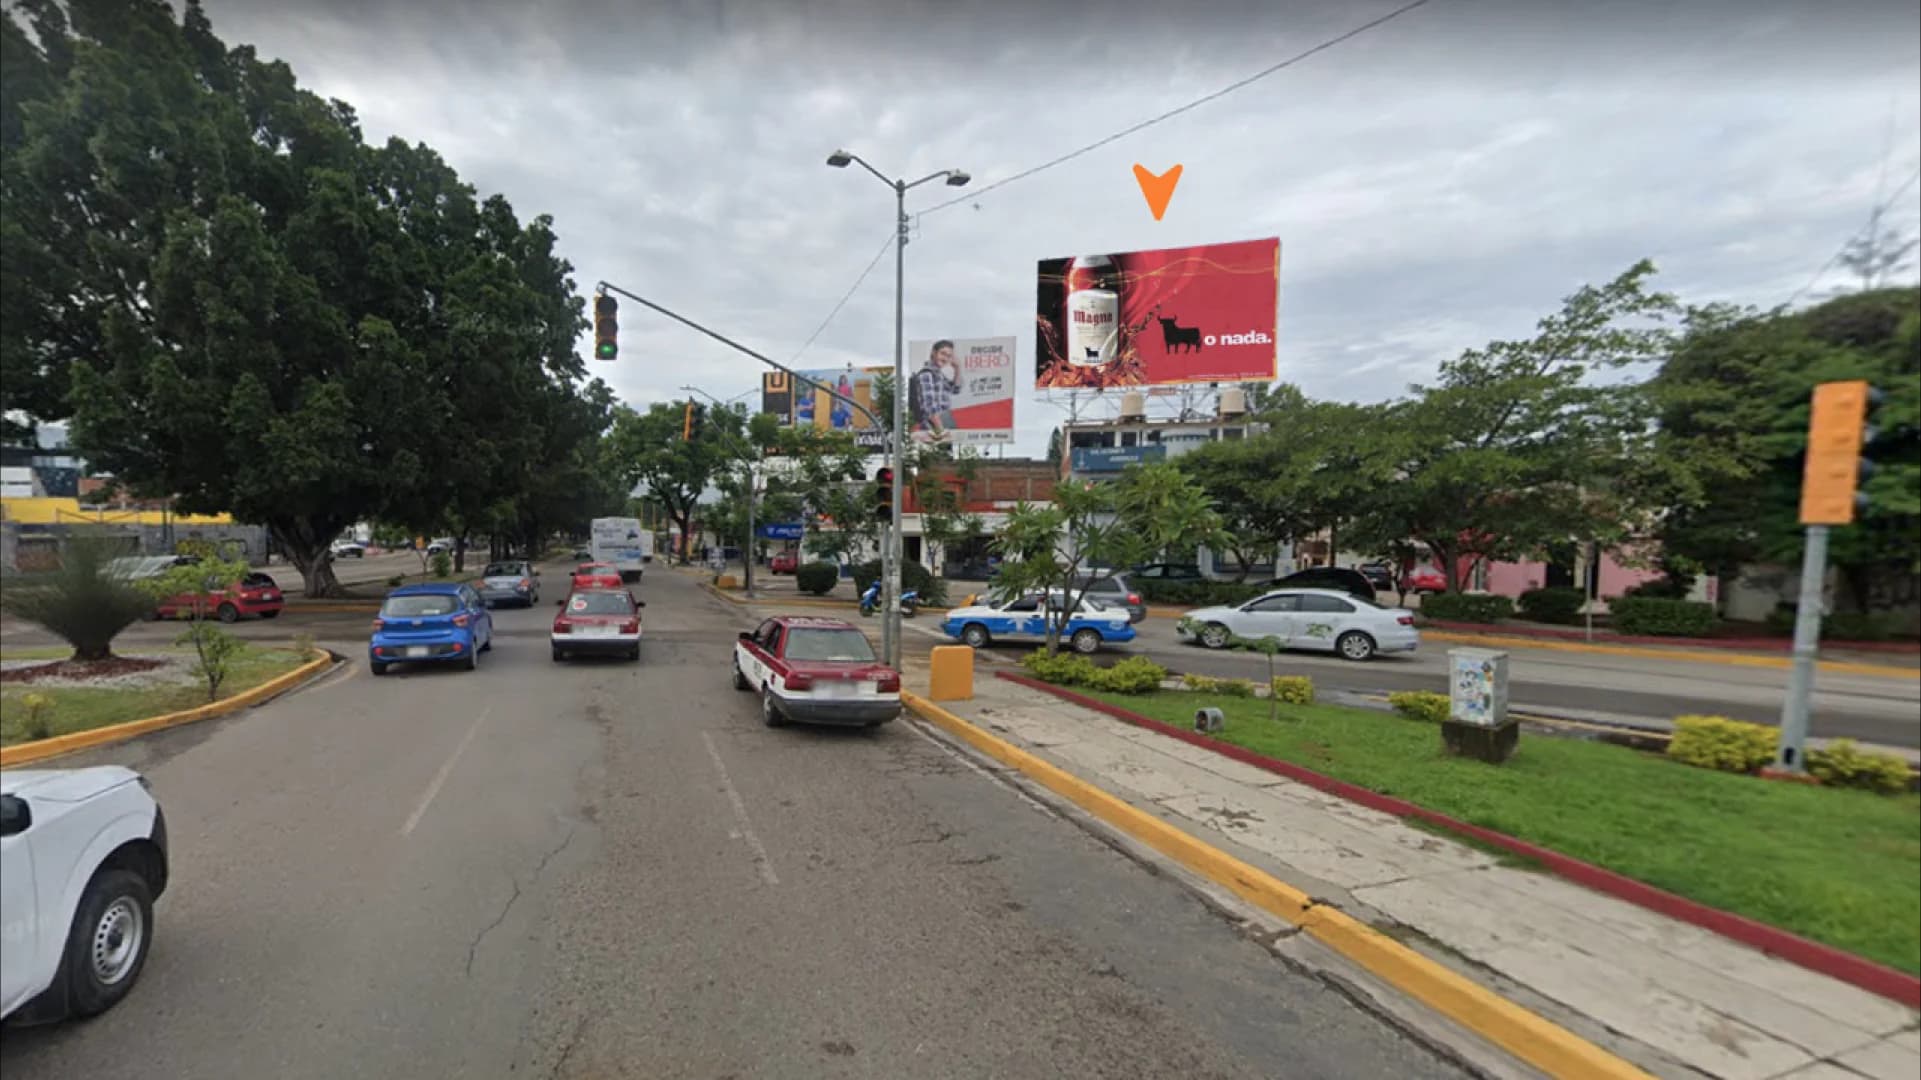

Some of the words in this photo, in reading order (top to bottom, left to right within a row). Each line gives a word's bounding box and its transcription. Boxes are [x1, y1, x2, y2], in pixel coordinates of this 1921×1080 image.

[1204, 335, 1216, 346] o
[1220, 331, 1272, 346] nada.
[965, 354, 1009, 368] IBERO
